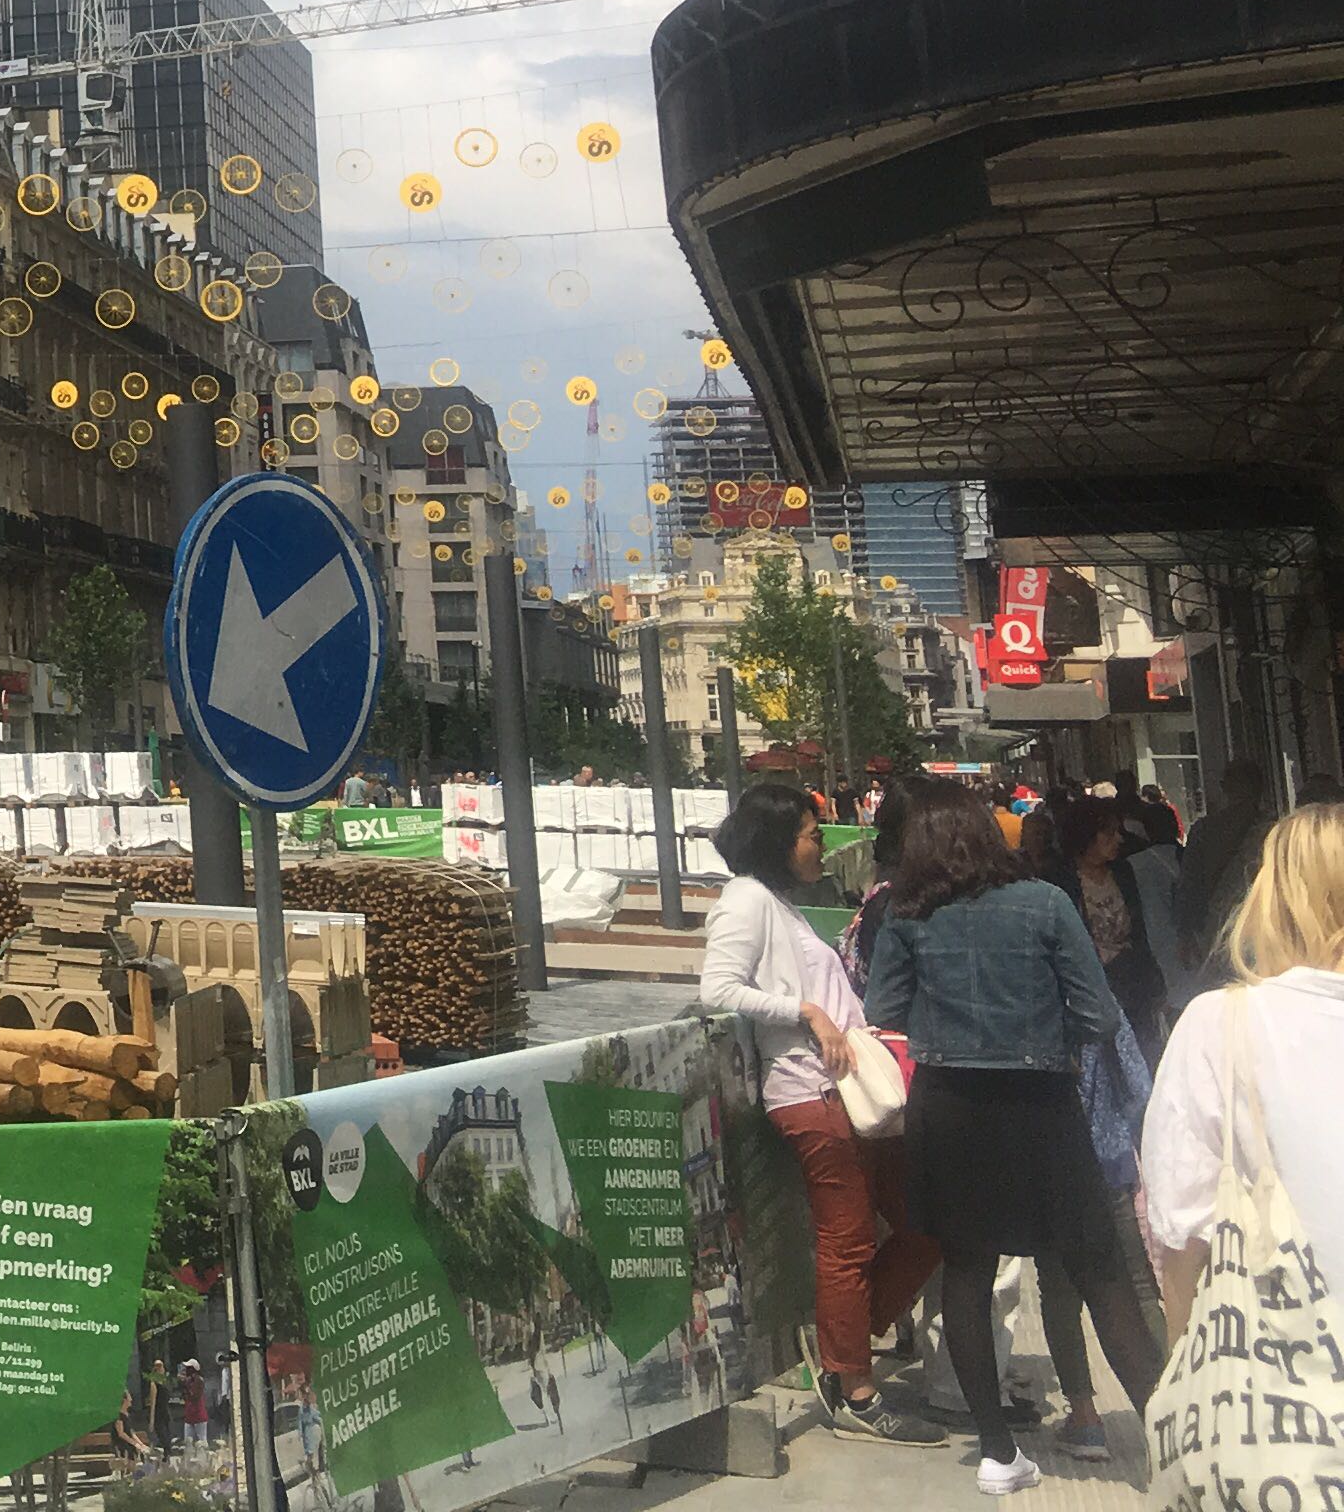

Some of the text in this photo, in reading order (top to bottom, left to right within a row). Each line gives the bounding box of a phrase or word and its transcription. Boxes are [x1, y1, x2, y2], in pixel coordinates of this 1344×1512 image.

[1001, 620, 1035, 654] Q
[1001, 664, 1038, 676] Quick
[343, 817, 399, 843] BXL
[608, 1109, 679, 1129] HIER BOUWEN
[329, 1148, 360, 1163] LA VILLE
[568, 1139, 584, 1157] WE
[587, 1139, 607, 1157] EEN
[664, 1140, 679, 1159] EN
[328, 1160, 359, 1175] DE STAD
[290, 1168, 317, 1193] BXL
[605, 1168, 681, 1189] AANGENAMER
[32, 1201, 93, 1227] vraag
[605, 1198, 682, 1216] STADSCENTRUM
[13, 1231, 54, 1248] een
[629, 1227, 652, 1246] MET
[325, 1232, 363, 1267] NOUS
[309, 1243, 404, 1307] CONSTRUISONS
[51, 1303, 74, 1314] ons
[316, 1271, 420, 1342] UN CENTRE-VILLE
[320, 1294, 441, 1378] PLUS RESPIRABLE,
[3, 1369, 48, 1383] maandag
[49, 1370, 65, 1383] tot
[322, 1324, 452, 1412] PLUS VERT ET PLUS
[330, 1388, 402, 1449] AGRÉABLE.
